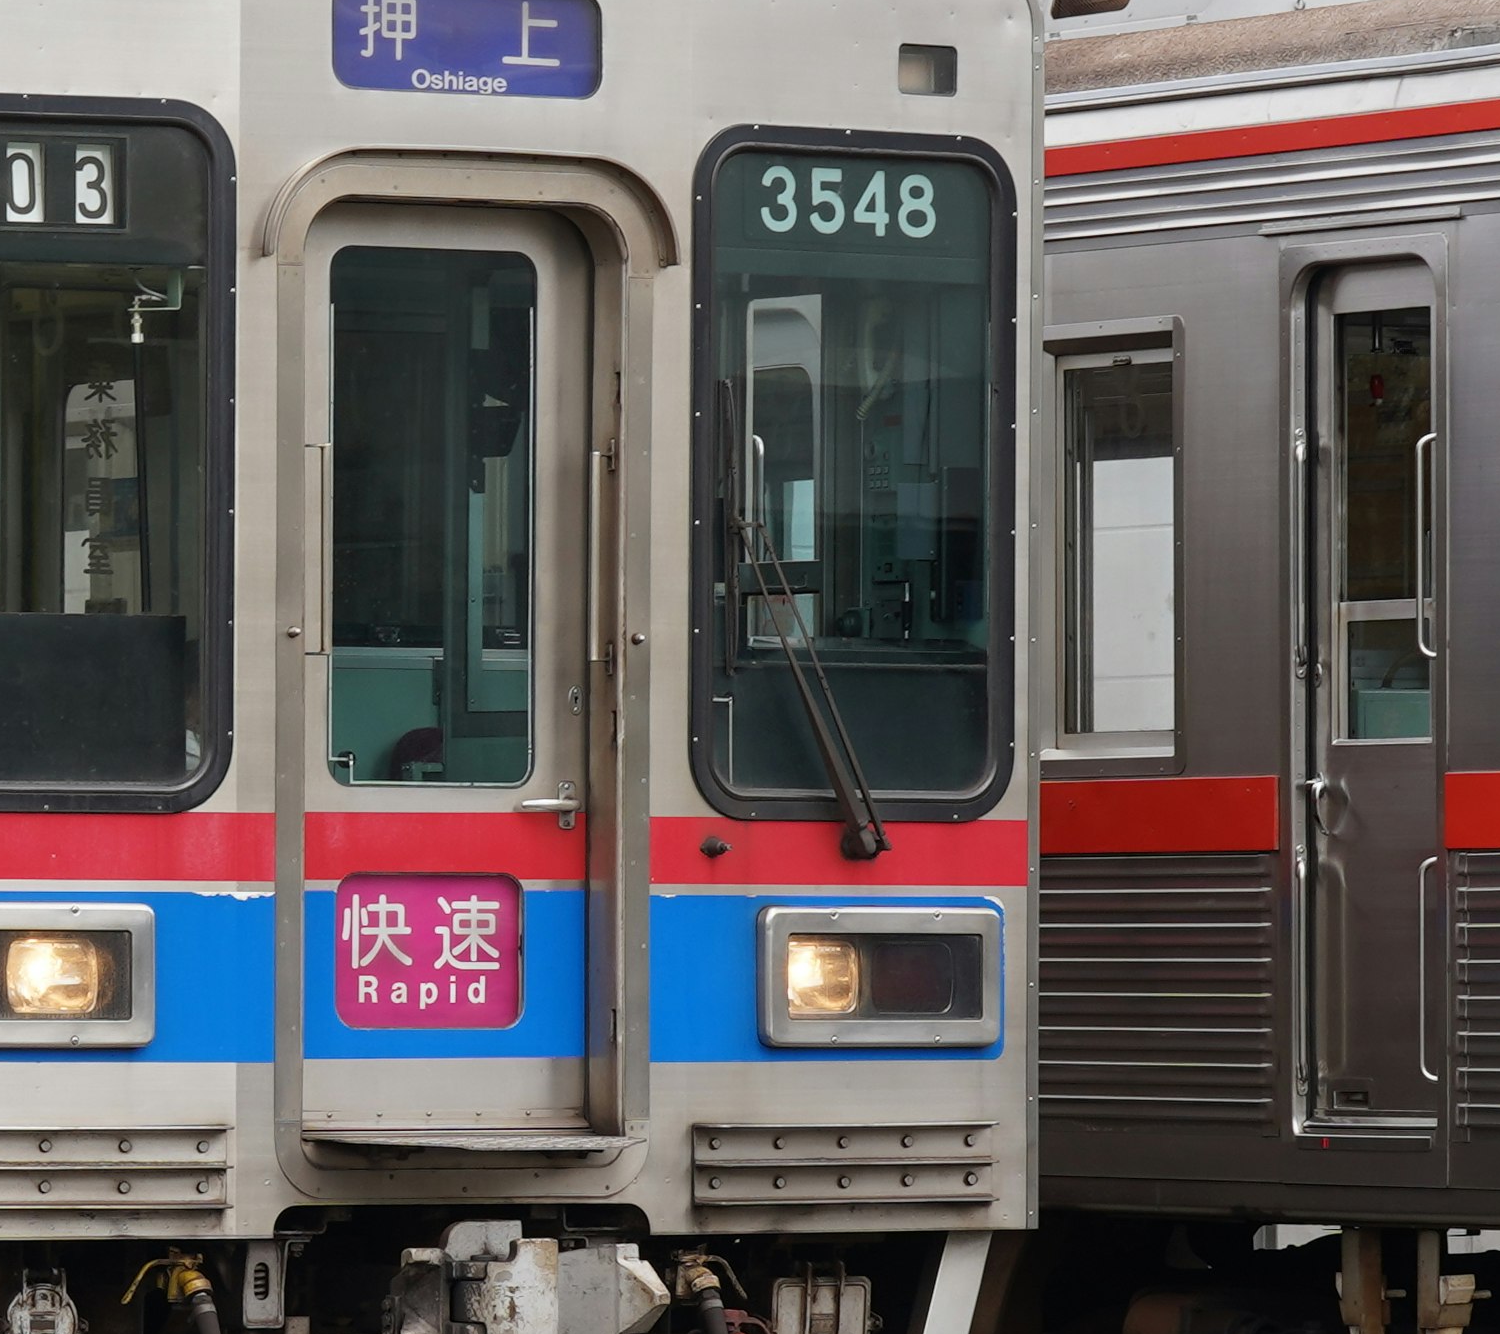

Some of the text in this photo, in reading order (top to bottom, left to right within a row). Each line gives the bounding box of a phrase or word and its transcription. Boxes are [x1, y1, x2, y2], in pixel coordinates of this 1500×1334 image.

[411, 68, 508, 95] Oshiage
[760, 166, 936, 238] 3548
[342, 894, 500, 970] 快速
[358, 975, 486, 1004] Rapid
